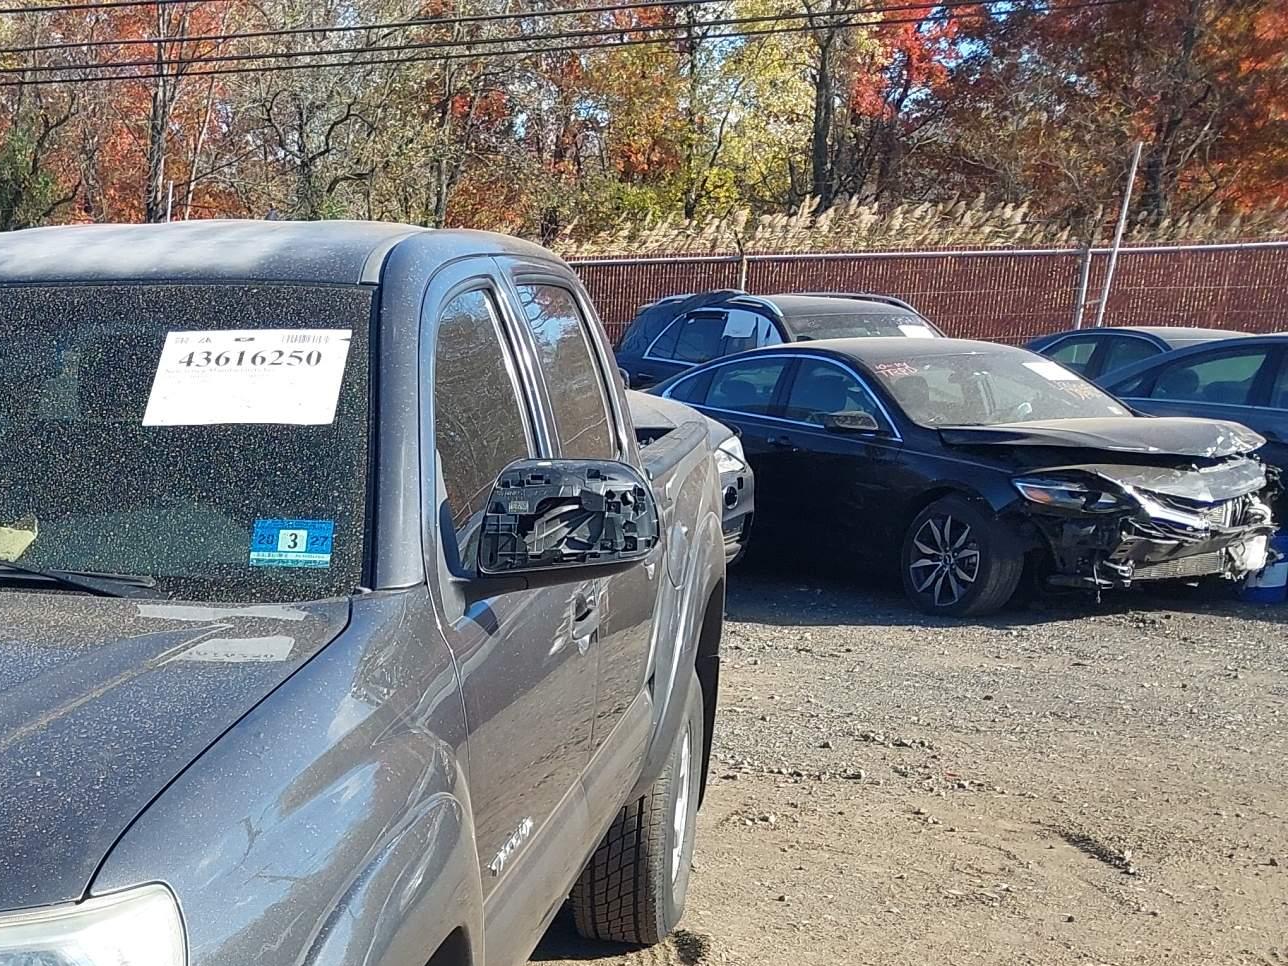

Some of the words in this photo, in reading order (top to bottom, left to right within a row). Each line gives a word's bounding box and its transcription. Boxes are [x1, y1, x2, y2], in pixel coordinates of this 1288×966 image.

[178, 350, 322, 367] 43616250
[287, 532, 299, 549] 3
[310, 536, 329, 547] 27
